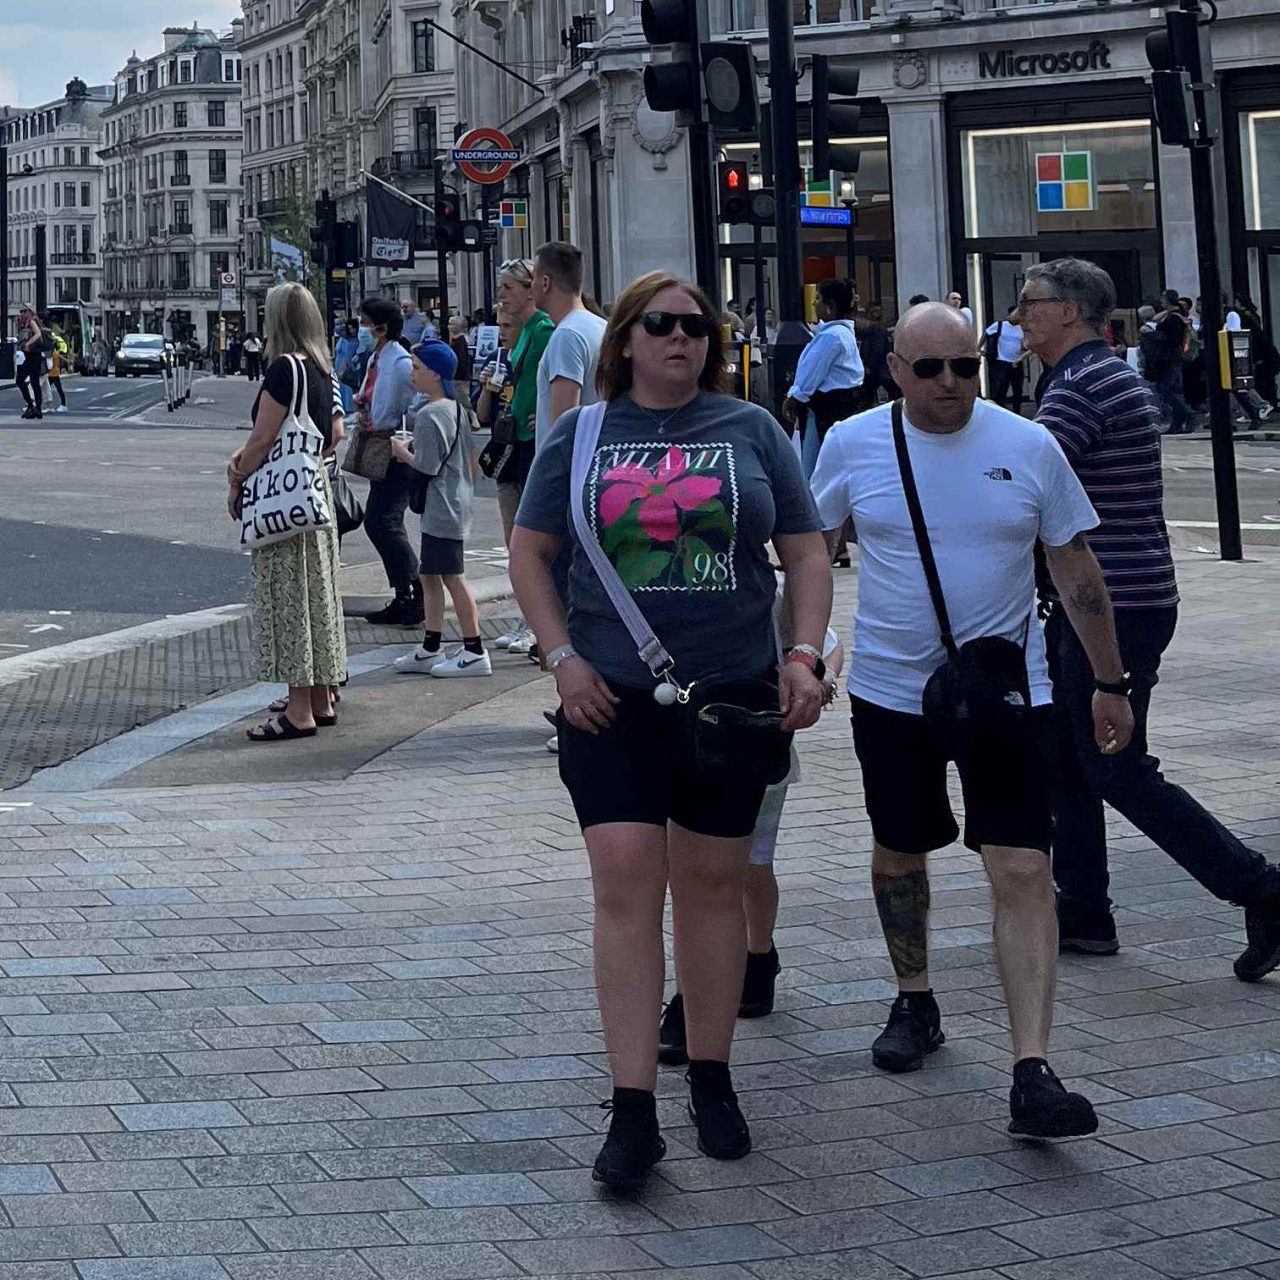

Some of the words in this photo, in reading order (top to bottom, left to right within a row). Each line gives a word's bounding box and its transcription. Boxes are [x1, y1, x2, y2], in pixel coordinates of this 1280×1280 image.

[978, 40, 1111, 78] Microsoft
[454, 151, 518, 160] UNDERGROUND
[604, 450, 725, 471] MIAMI
[691, 552, 729, 583] 98
